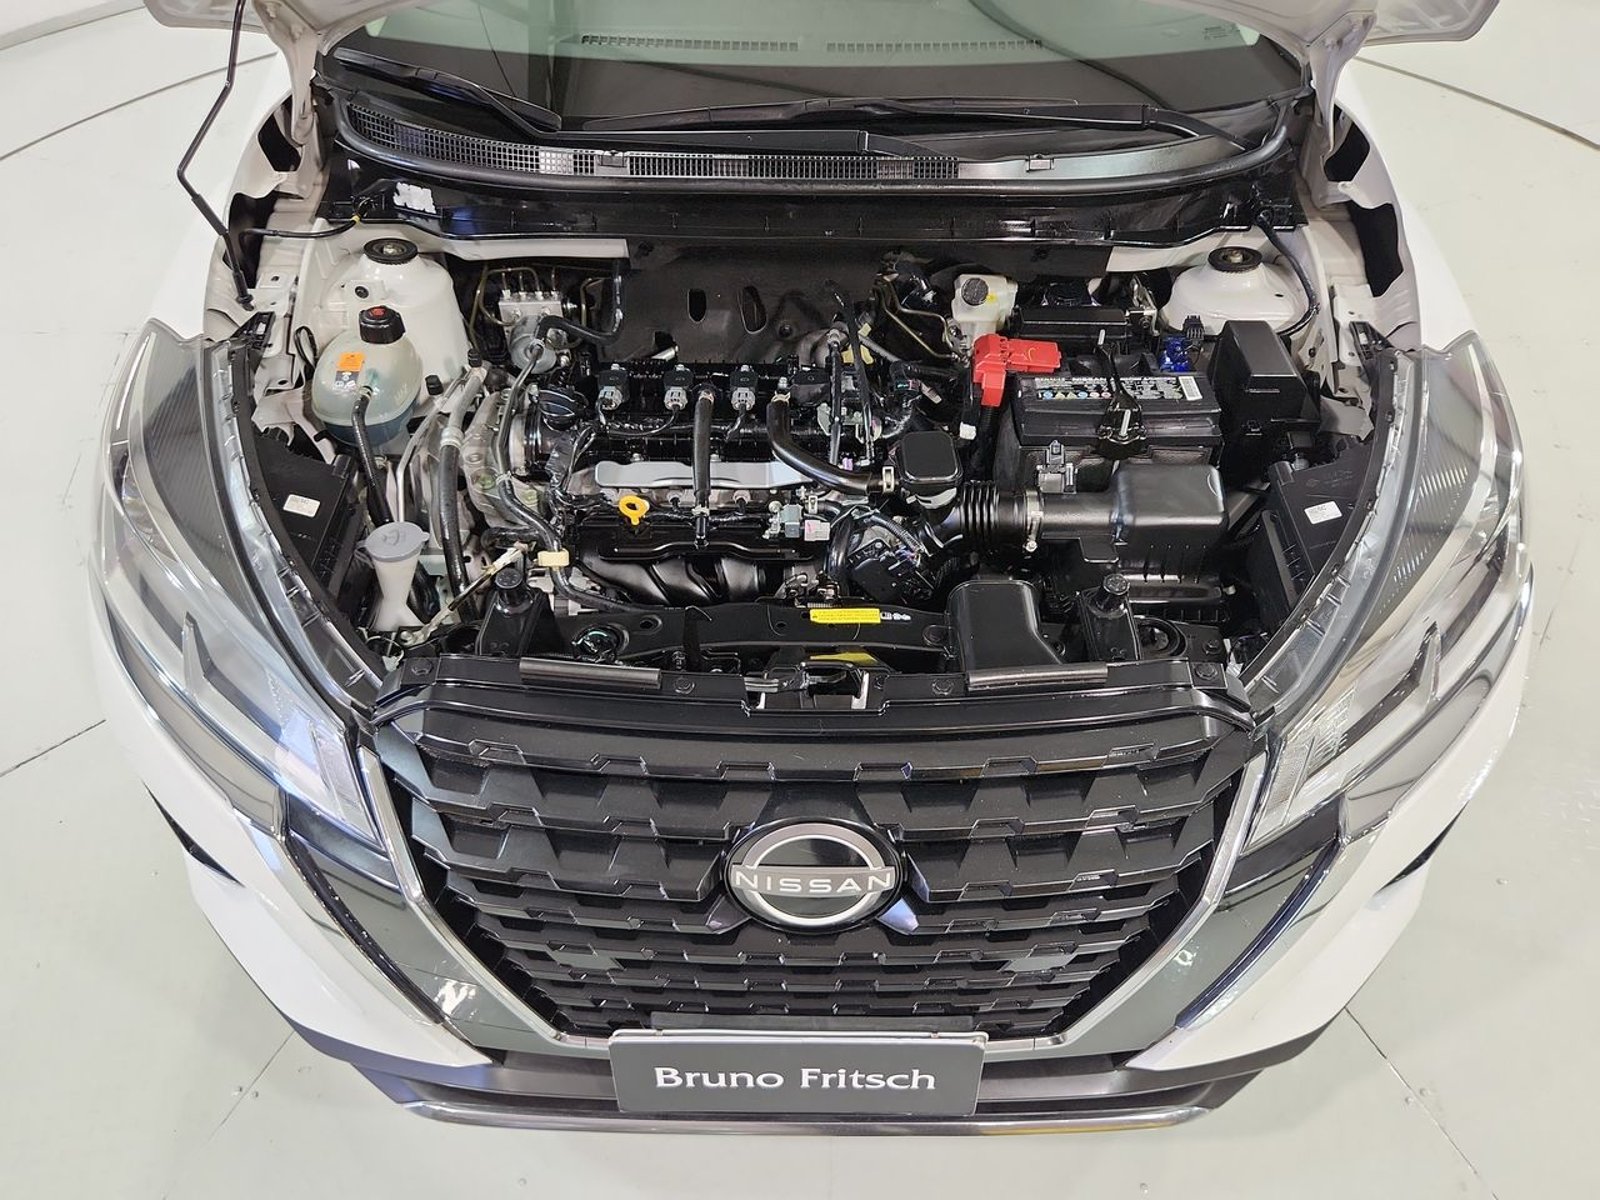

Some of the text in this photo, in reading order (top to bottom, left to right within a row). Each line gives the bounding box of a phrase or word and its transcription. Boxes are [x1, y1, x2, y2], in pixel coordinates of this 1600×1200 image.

[735, 871, 891, 893] NISSAN
[654, 1067, 936, 1090] Bruno Fritsch
